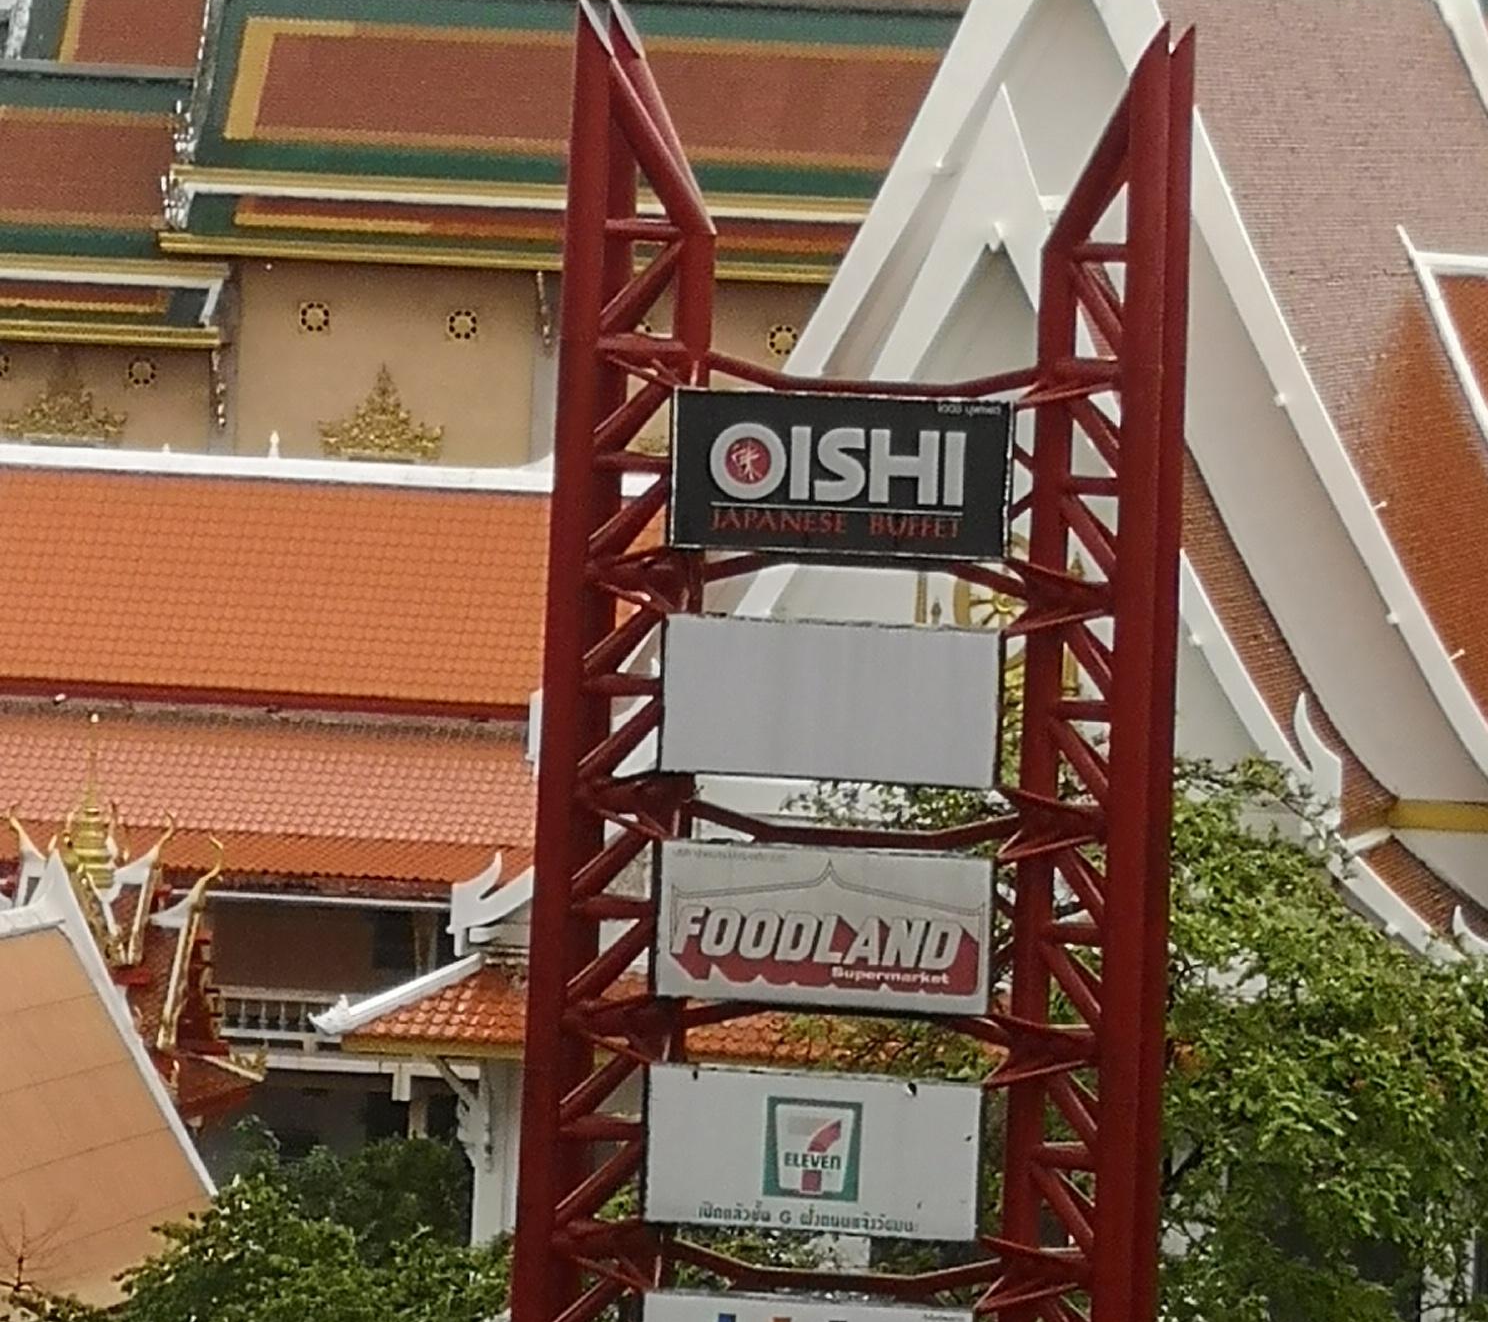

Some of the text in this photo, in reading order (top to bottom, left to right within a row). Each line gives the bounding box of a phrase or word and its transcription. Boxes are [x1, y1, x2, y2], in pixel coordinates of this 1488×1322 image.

[710, 422, 966, 506] OISHI
[711, 508, 961, 539] JAPANESE BUFFET
[672, 905, 964, 970] FOODLAND
[832, 966, 949, 984] Supermarket
[779, 1209, 793, 1225] G
